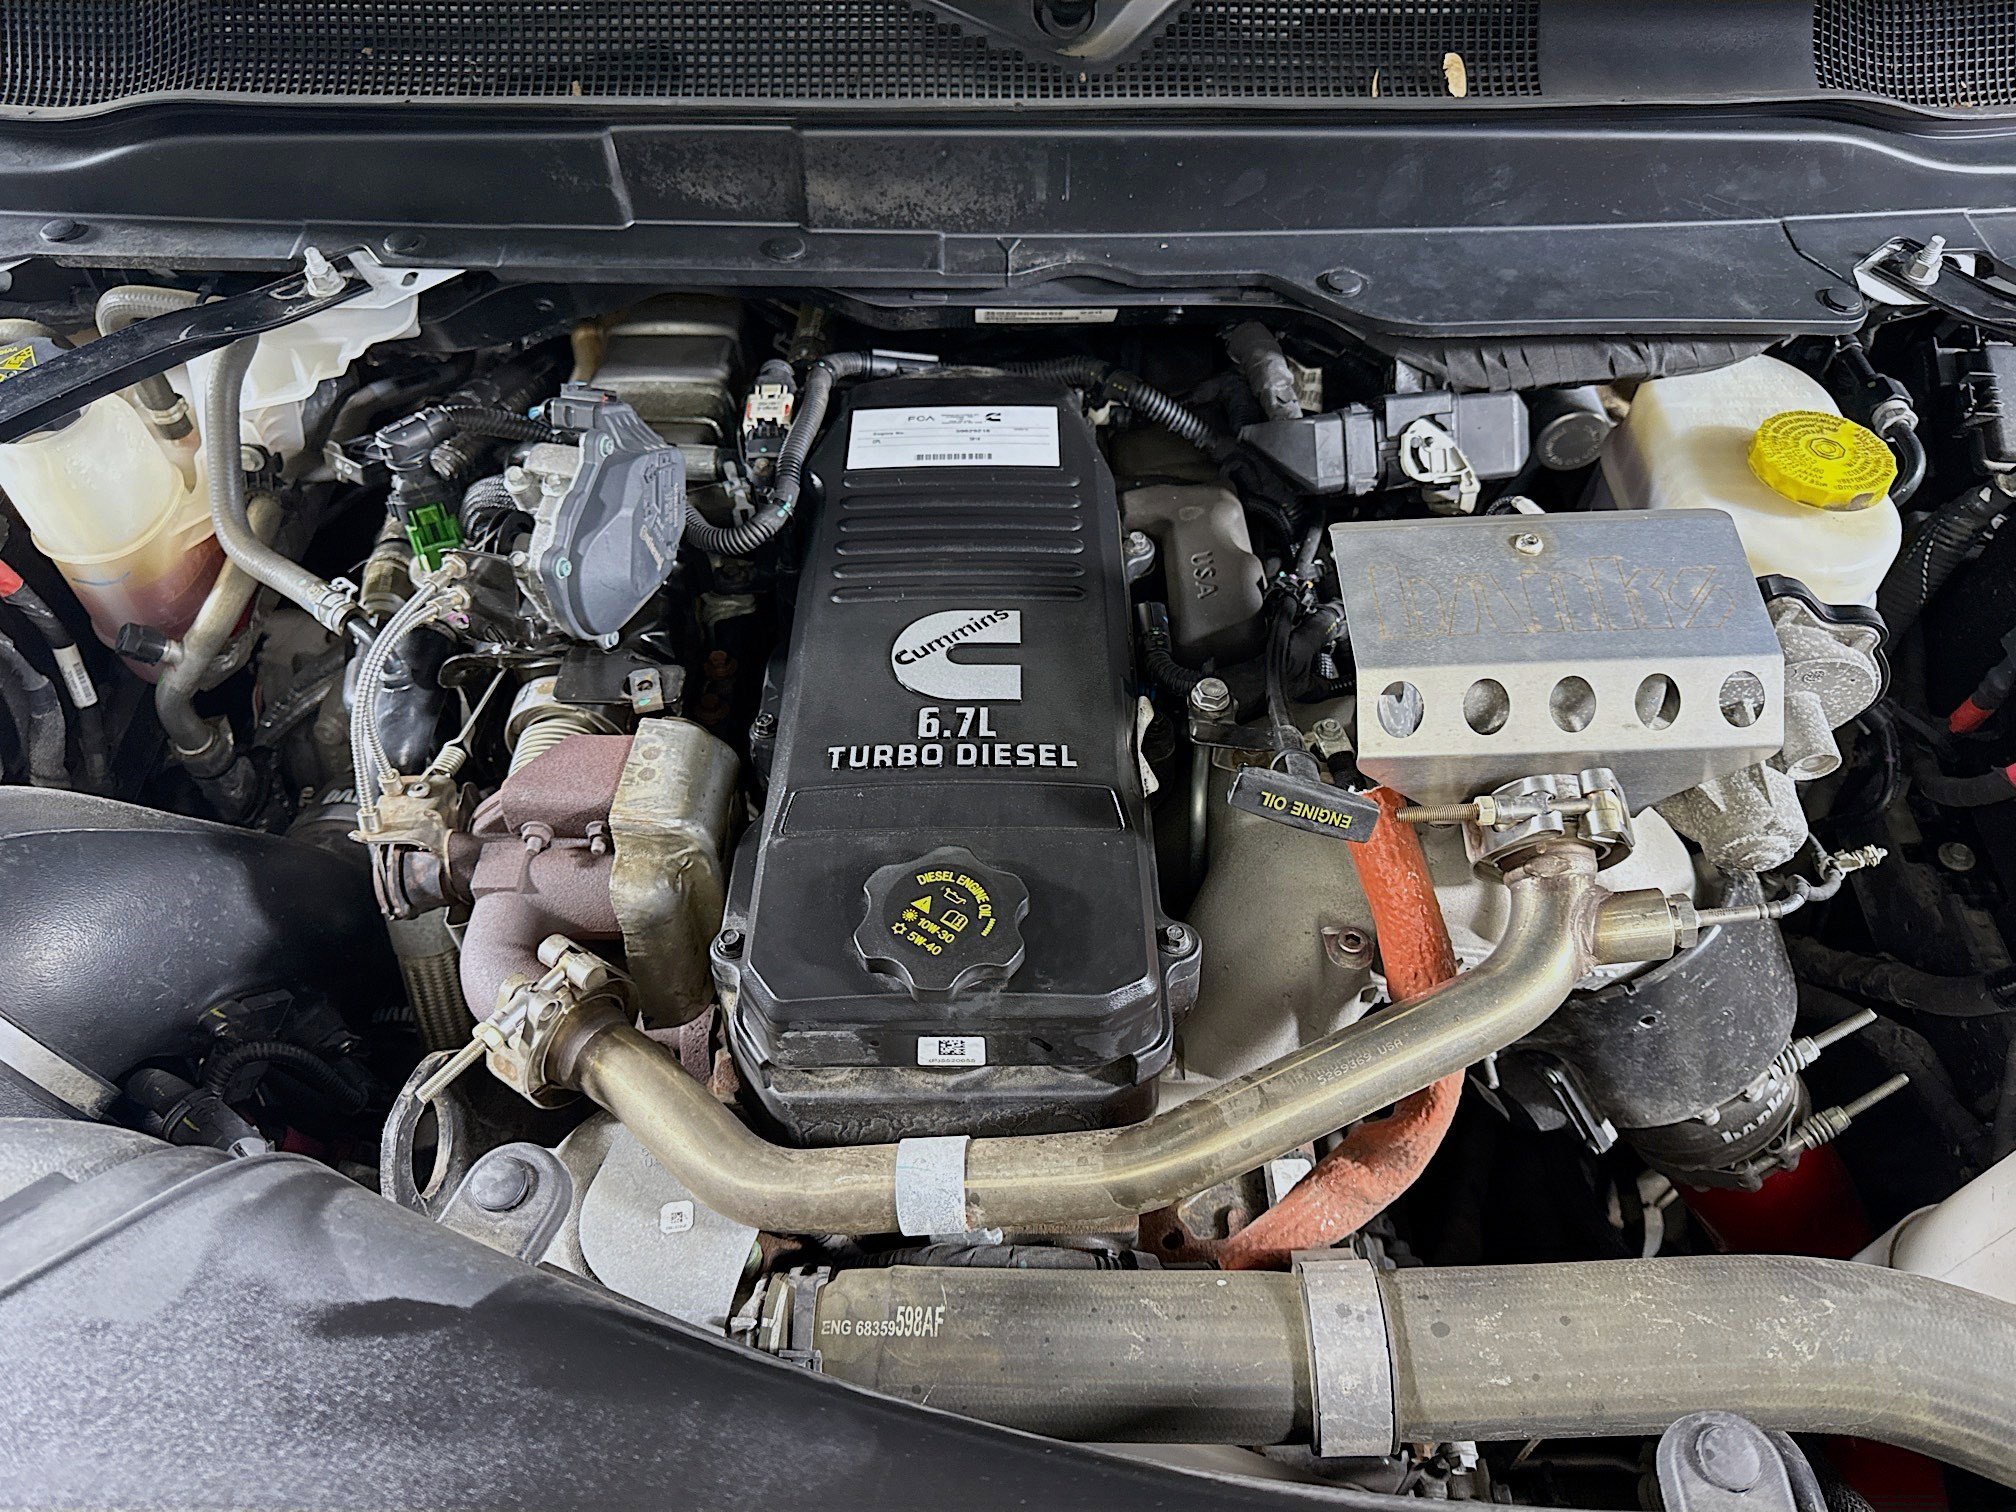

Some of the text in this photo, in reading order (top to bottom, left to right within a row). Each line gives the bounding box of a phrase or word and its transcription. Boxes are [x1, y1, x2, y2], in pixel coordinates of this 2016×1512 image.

[1191, 550, 1218, 600] USA
[894, 608, 1010, 665] Cummins
[918, 706, 997, 739] 6.7L
[827, 743, 1078, 770] TURBO DIESEL
[1260, 790, 1353, 829] ENGINE OIL
[916, 870, 992, 920] DIESEL ENGINE OIL
[906, 931, 943, 956] 5W-40
[917, 917, 956, 944] 10W-30
[1376, 1038, 1404, 1055] USA
[820, 1319, 852, 1335] ENG
